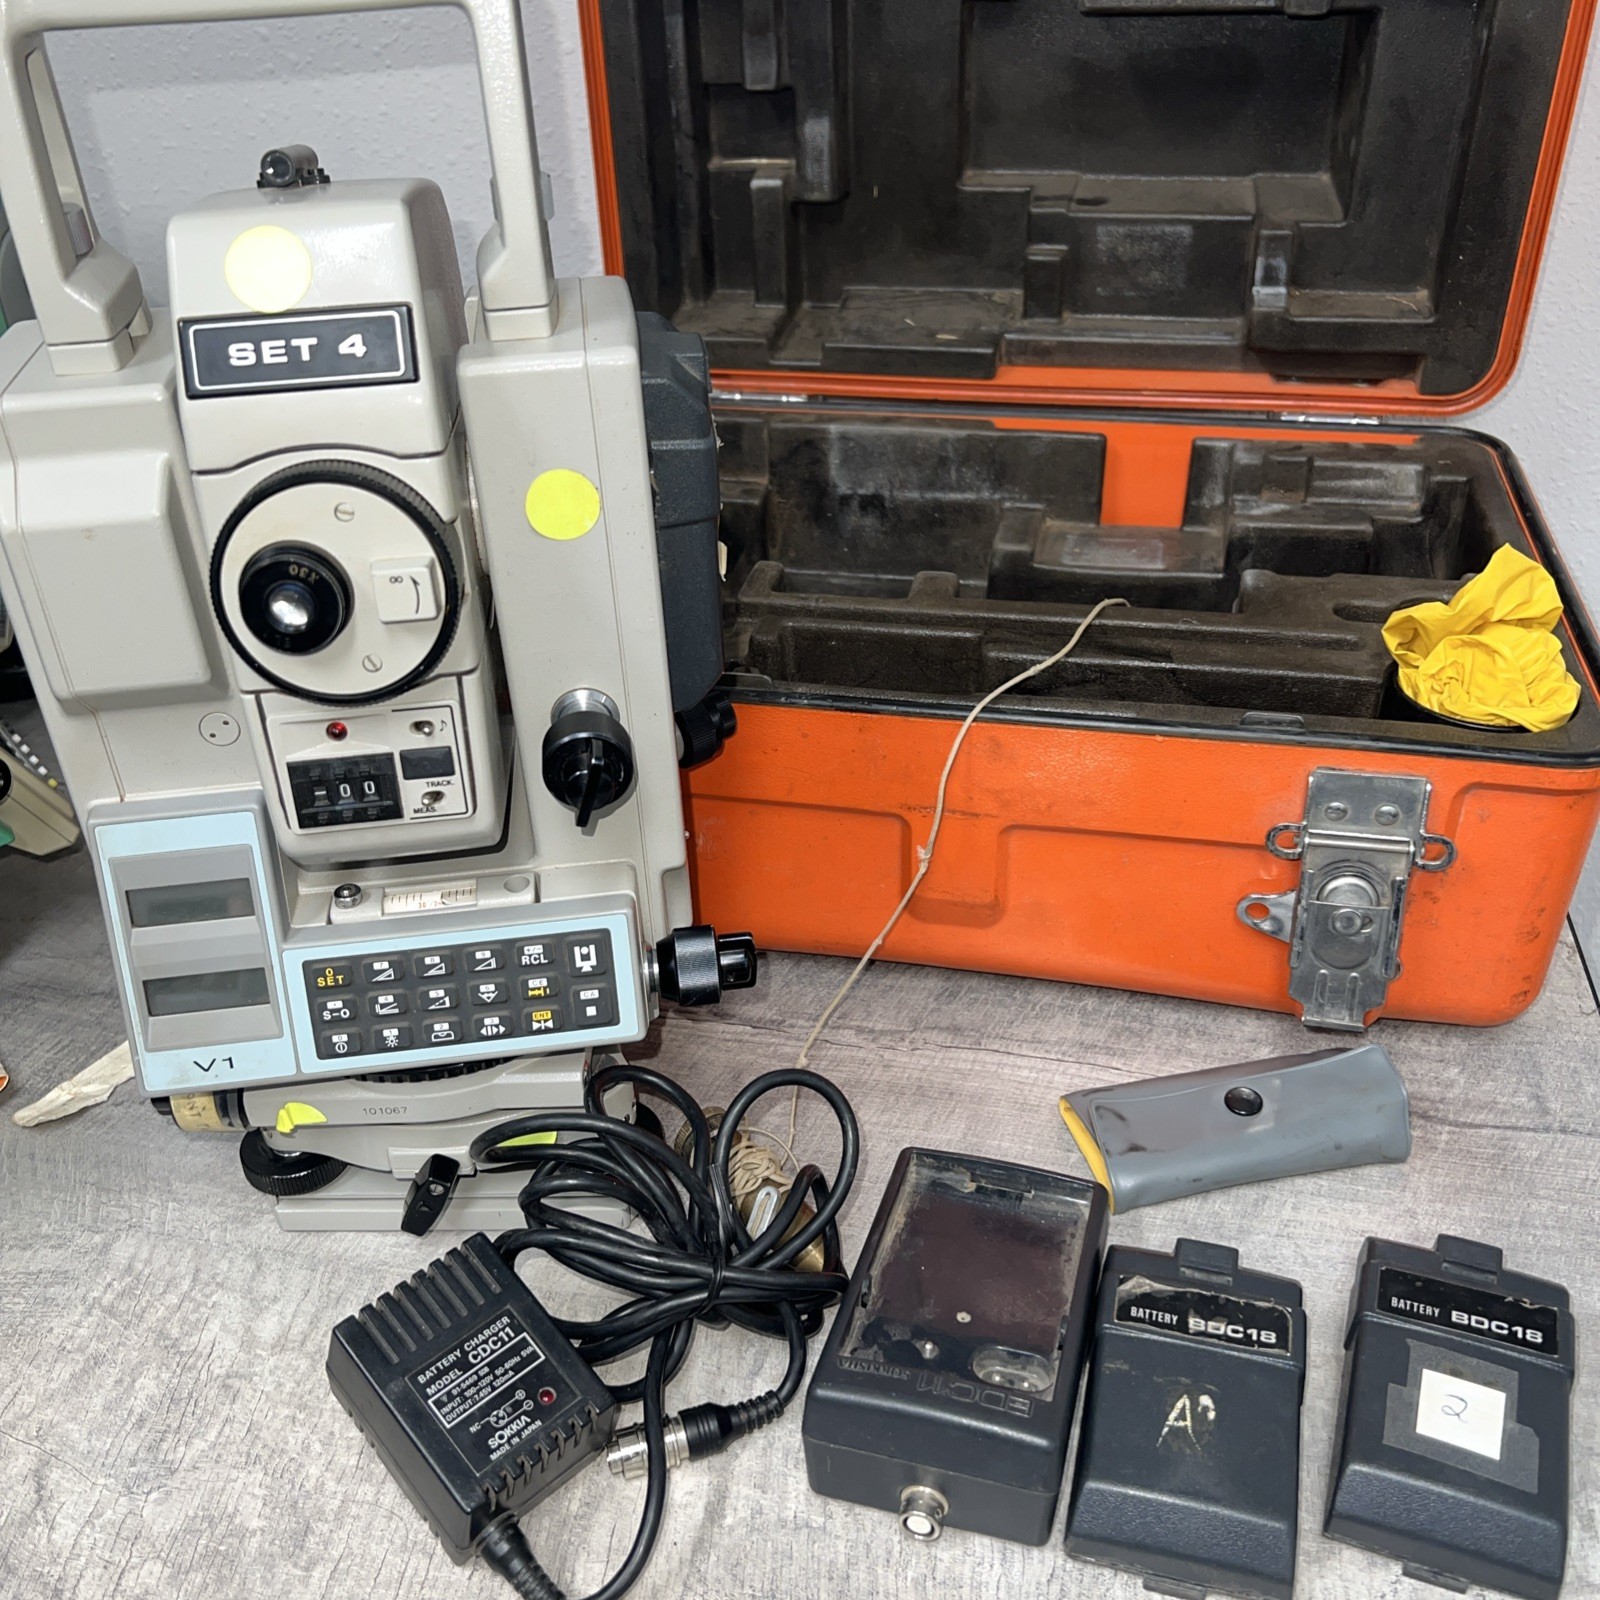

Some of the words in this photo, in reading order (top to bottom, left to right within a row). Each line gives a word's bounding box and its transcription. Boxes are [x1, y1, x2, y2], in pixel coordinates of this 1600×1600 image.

[228, 337, 318, 367] SET
[338, 333, 367, 358] 4
[521, 953, 548, 966] RCL
[316, 975, 344, 988] SET
[534, 1011, 550, 1020] ENT
[361, 1105, 408, 1117] 101067
[1130, 1306, 1178, 1326] BATTERY
[1188, 1317, 1277, 1344] BDC18
[1391, 1297, 1440, 1318] BATTERY
[1450, 1310, 1544, 1344] BDC18
[417, 1349, 462, 1384] BATTERY
[464, 1315, 511, 1352] CHARGER
[425, 1368, 463, 1397] MODEL
[468, 1326, 515, 1365] CDC11
[440, 1396, 465, 1416] INPUT:
[916, 1371, 1033, 1418] EDC11
[1441, 1394, 1469, 1424] 2
[469, 1422, 482, 1434] NC
[487, 1415, 532, 1449] SOKKIA
[489, 1442, 511, 1462] MADE
[510, 1435, 521, 1446] IN
[520, 1419, 543, 1440] JAPAN
